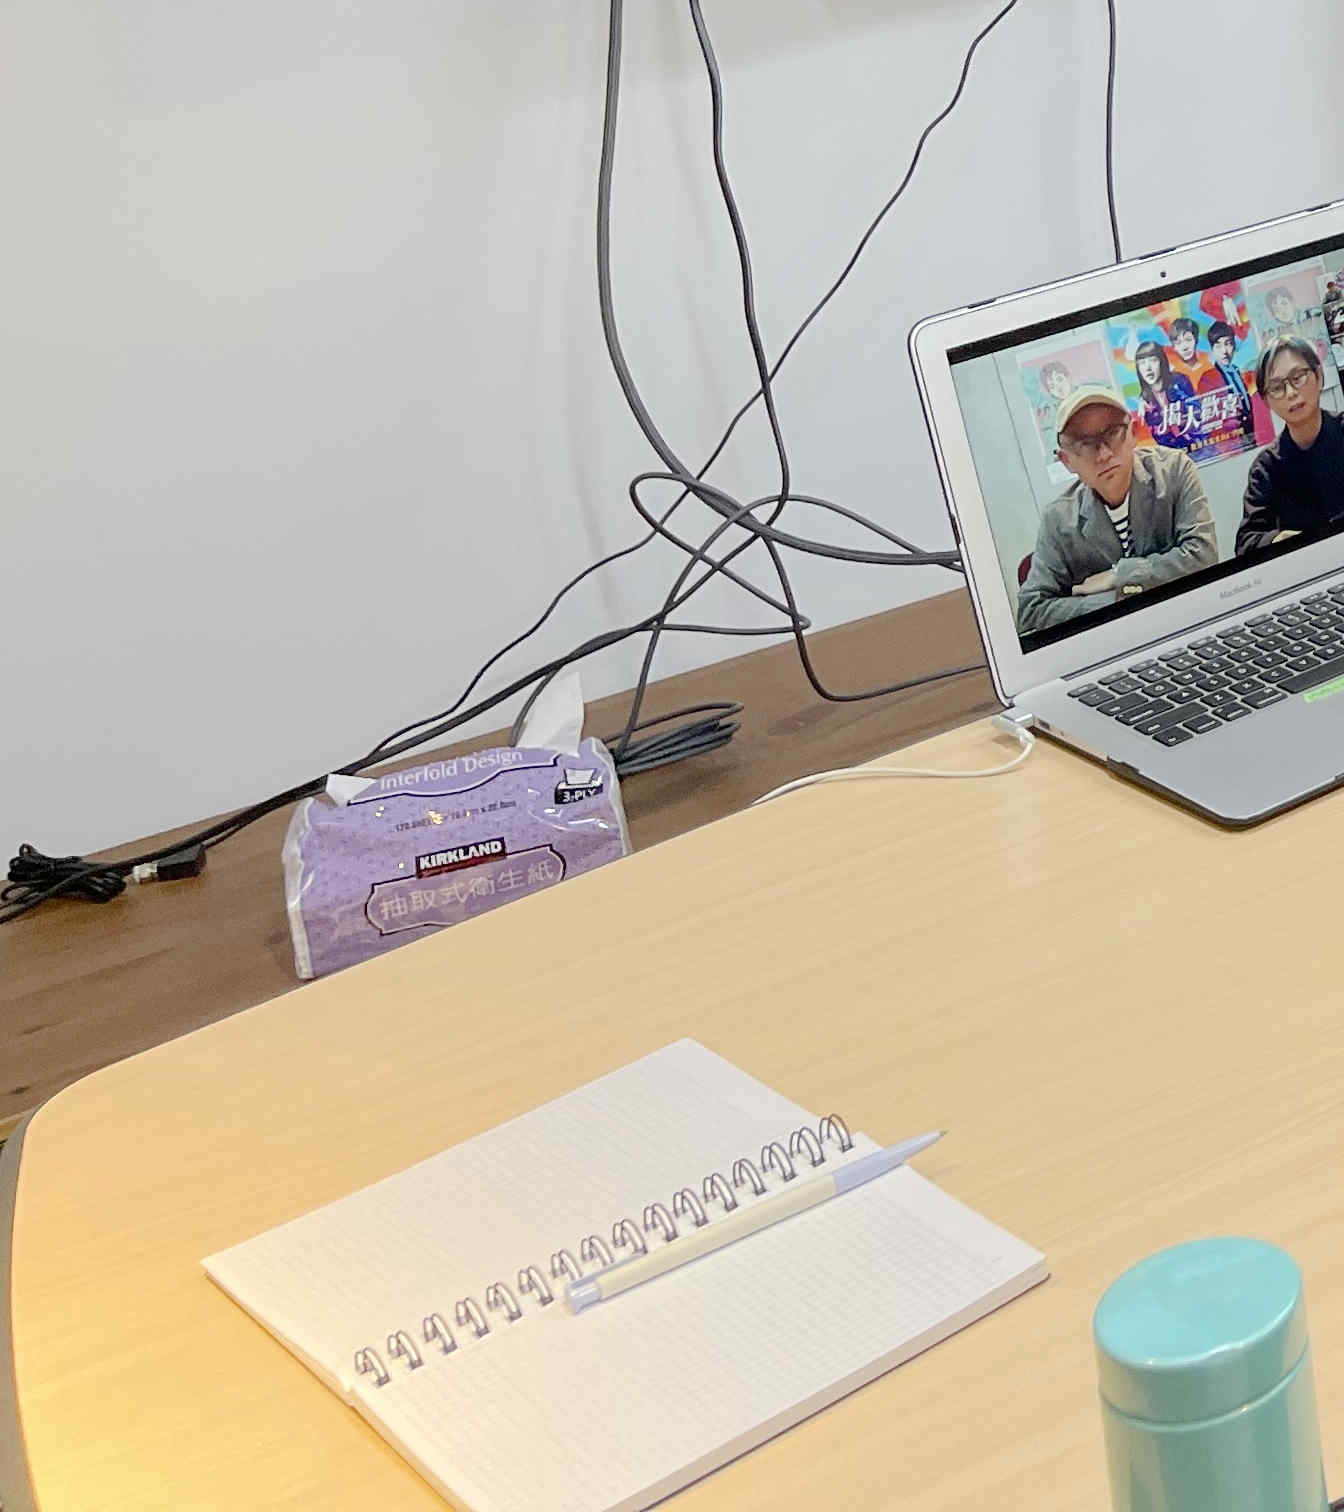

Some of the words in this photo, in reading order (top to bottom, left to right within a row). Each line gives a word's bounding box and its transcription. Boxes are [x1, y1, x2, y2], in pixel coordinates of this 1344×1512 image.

[380, 757, 458, 791] Interfold
[462, 747, 523, 774] Design
[562, 788, 597, 803] 3-PLY
[419, 840, 503, 870] KIRKLAND
[380, 867, 556, 922] 抽取式衛生紙
